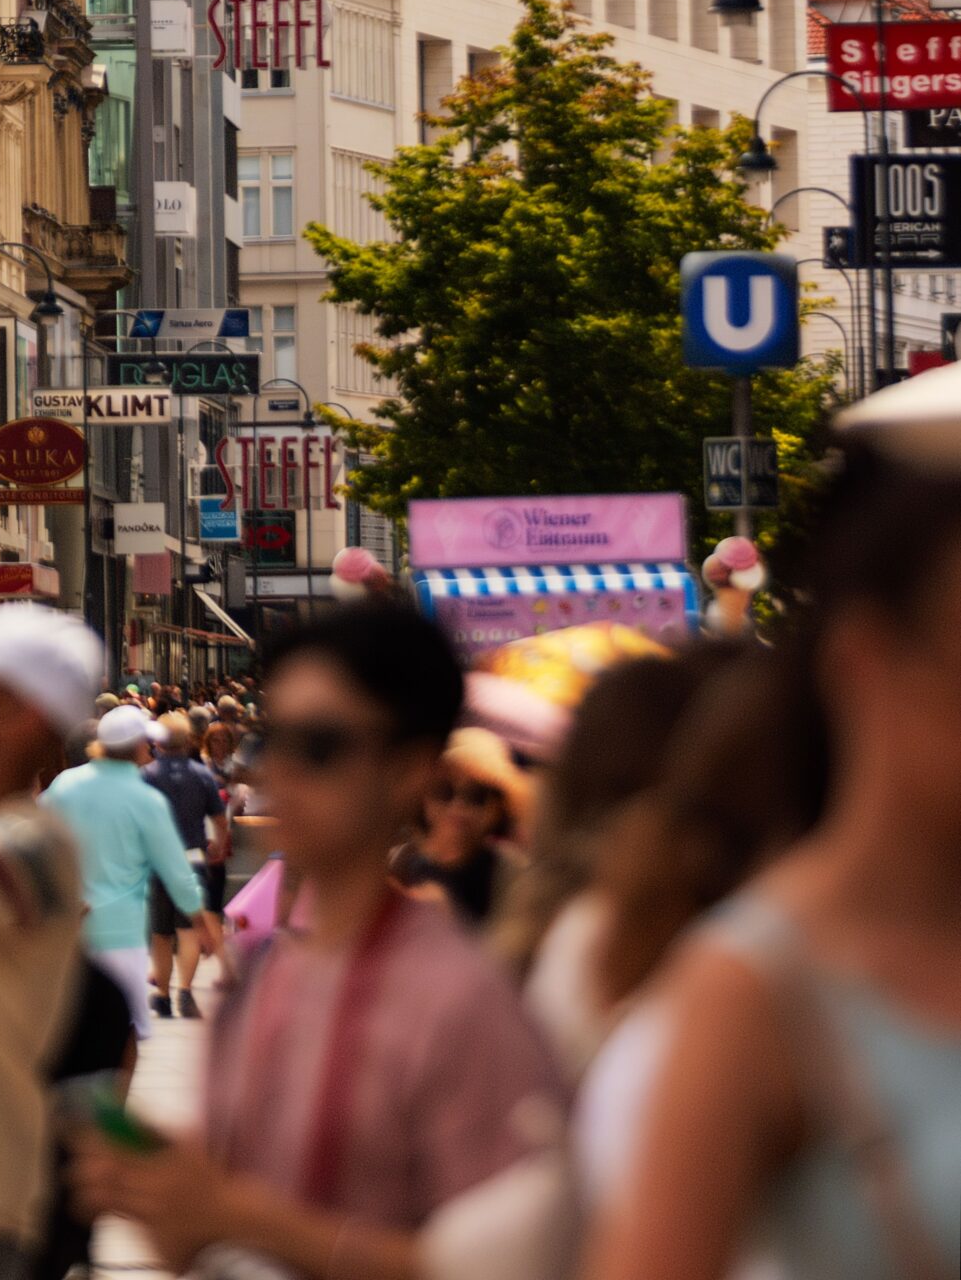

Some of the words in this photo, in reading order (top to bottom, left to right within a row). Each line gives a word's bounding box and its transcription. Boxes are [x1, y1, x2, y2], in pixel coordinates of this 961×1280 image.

[701, 275, 775, 352] U
[34, 395, 84, 408] GUSTAV
[86, 394, 170, 417] KLIMT
[215, 436, 341, 510] STEFFL
